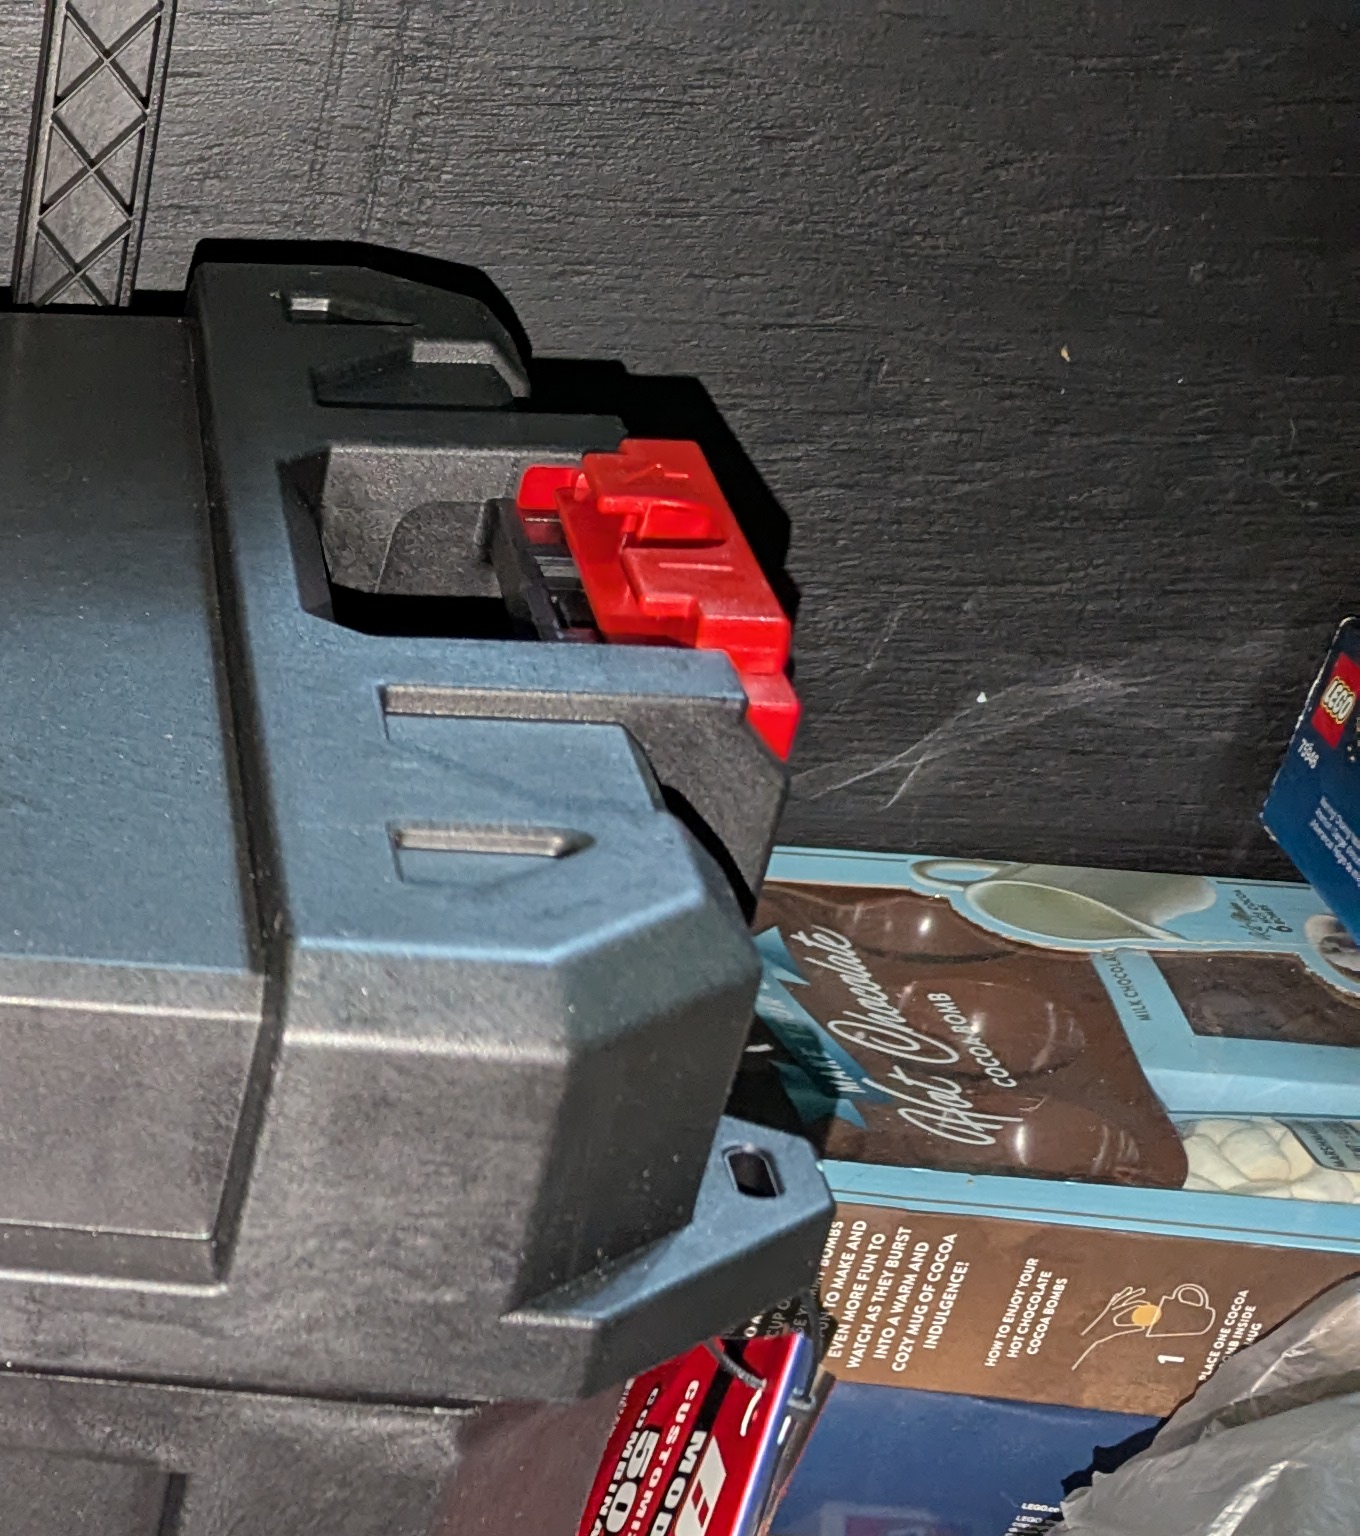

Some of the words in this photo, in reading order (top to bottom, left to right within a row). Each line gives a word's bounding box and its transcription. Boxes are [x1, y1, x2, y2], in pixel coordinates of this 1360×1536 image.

[1324, 678, 1354, 723] LEGO
[926, 992, 977, 1035] BOMB
[1129, 1000, 1152, 1021] MILK
[962, 1035, 1017, 1088] COCOA
[821, 1221, 845, 1268] BOMBS
[823, 1292, 841, 1309] TO
[835, 1252, 857, 1290] MAKE
[851, 1220, 868, 1250] AND
[885, 1226, 913, 1269] BURST
[909, 1241, 930, 1272] AND
[871, 1270, 896, 1305] THEY
[891, 1271, 918, 1313] WARM
[1016, 1258, 1039, 1288] YOUR
[827, 1324, 851, 1358] EVEN
[841, 1283, 868, 1322] MORE
[859, 1253, 880, 1281] FUN
[870, 1233, 887, 1254] TO
[867, 1304, 883, 1323] AS
[891, 1337, 916, 1372] COZY
[907, 1305, 929, 1336] MUG
[918, 1283, 936, 1304] OF
[927, 1233, 958, 1283] COCOA
[923, 1261, 970, 1350] INDULGENCE!
[1002, 1289, 1025, 1323] ENJOY
[1006, 1335, 1025, 1358] HOT
[1016, 1270, 1052, 1334] CHOCOLATE
[1026, 1316, 1052, 1355] COCOA
[1042, 1278, 1068, 1315] BOMBS
[889, 1315, 902, 1327] A
[995, 1324, 1011, 1339] TO
[1198, 1351, 1221, 1381] PLACE
[1213, 1327, 1232, 1350] ONE
[1224, 1289, 1250, 1326] COCOA
[1232, 1305, 1257, 1339] INSIDE
[846, 1323, 874, 1368] WATCH
[873, 1328, 896, 1359] INTO
[984, 1340, 1004, 1367] HOW
[1157, 1355, 1185, 1364] 1
